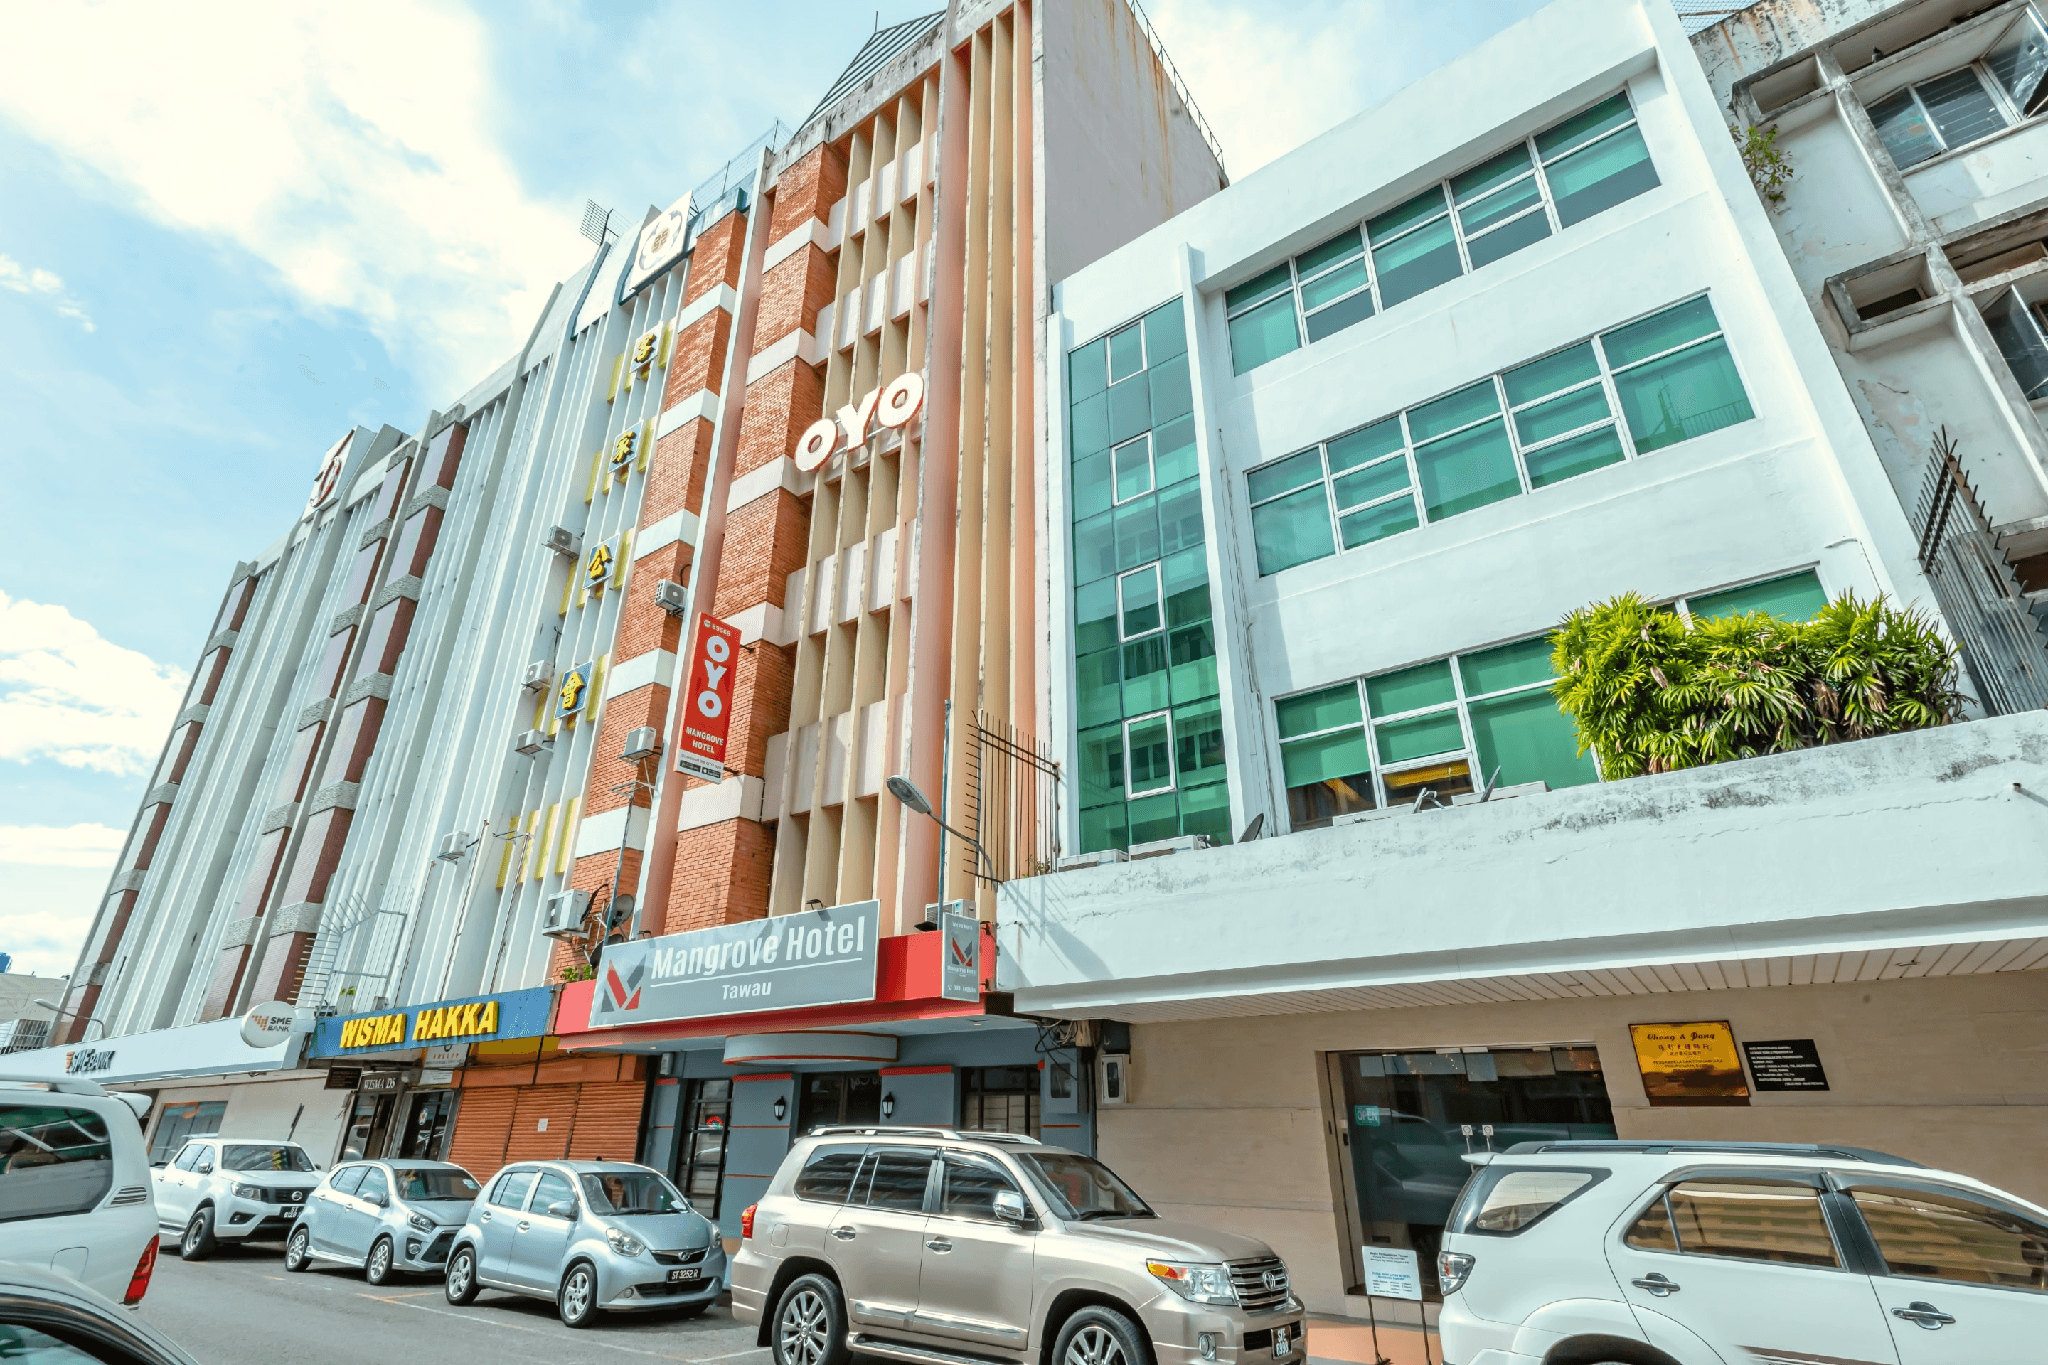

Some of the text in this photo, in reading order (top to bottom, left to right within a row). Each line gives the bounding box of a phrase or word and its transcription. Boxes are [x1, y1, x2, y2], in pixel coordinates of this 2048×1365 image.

[795, 372, 924, 471] OYO
[697, 635, 730, 719] OYO
[685, 726, 724, 746] MANGROVE
[692, 740, 715, 754] HOTEL
[650, 915, 865, 979] Mangrove Hotel
[722, 982, 772, 1000] Tawau
[270, 1016, 292, 1025] SME
[340, 1001, 499, 1048] WISMA HAKKA
[1357, 1109, 1378, 1121] OPEN
